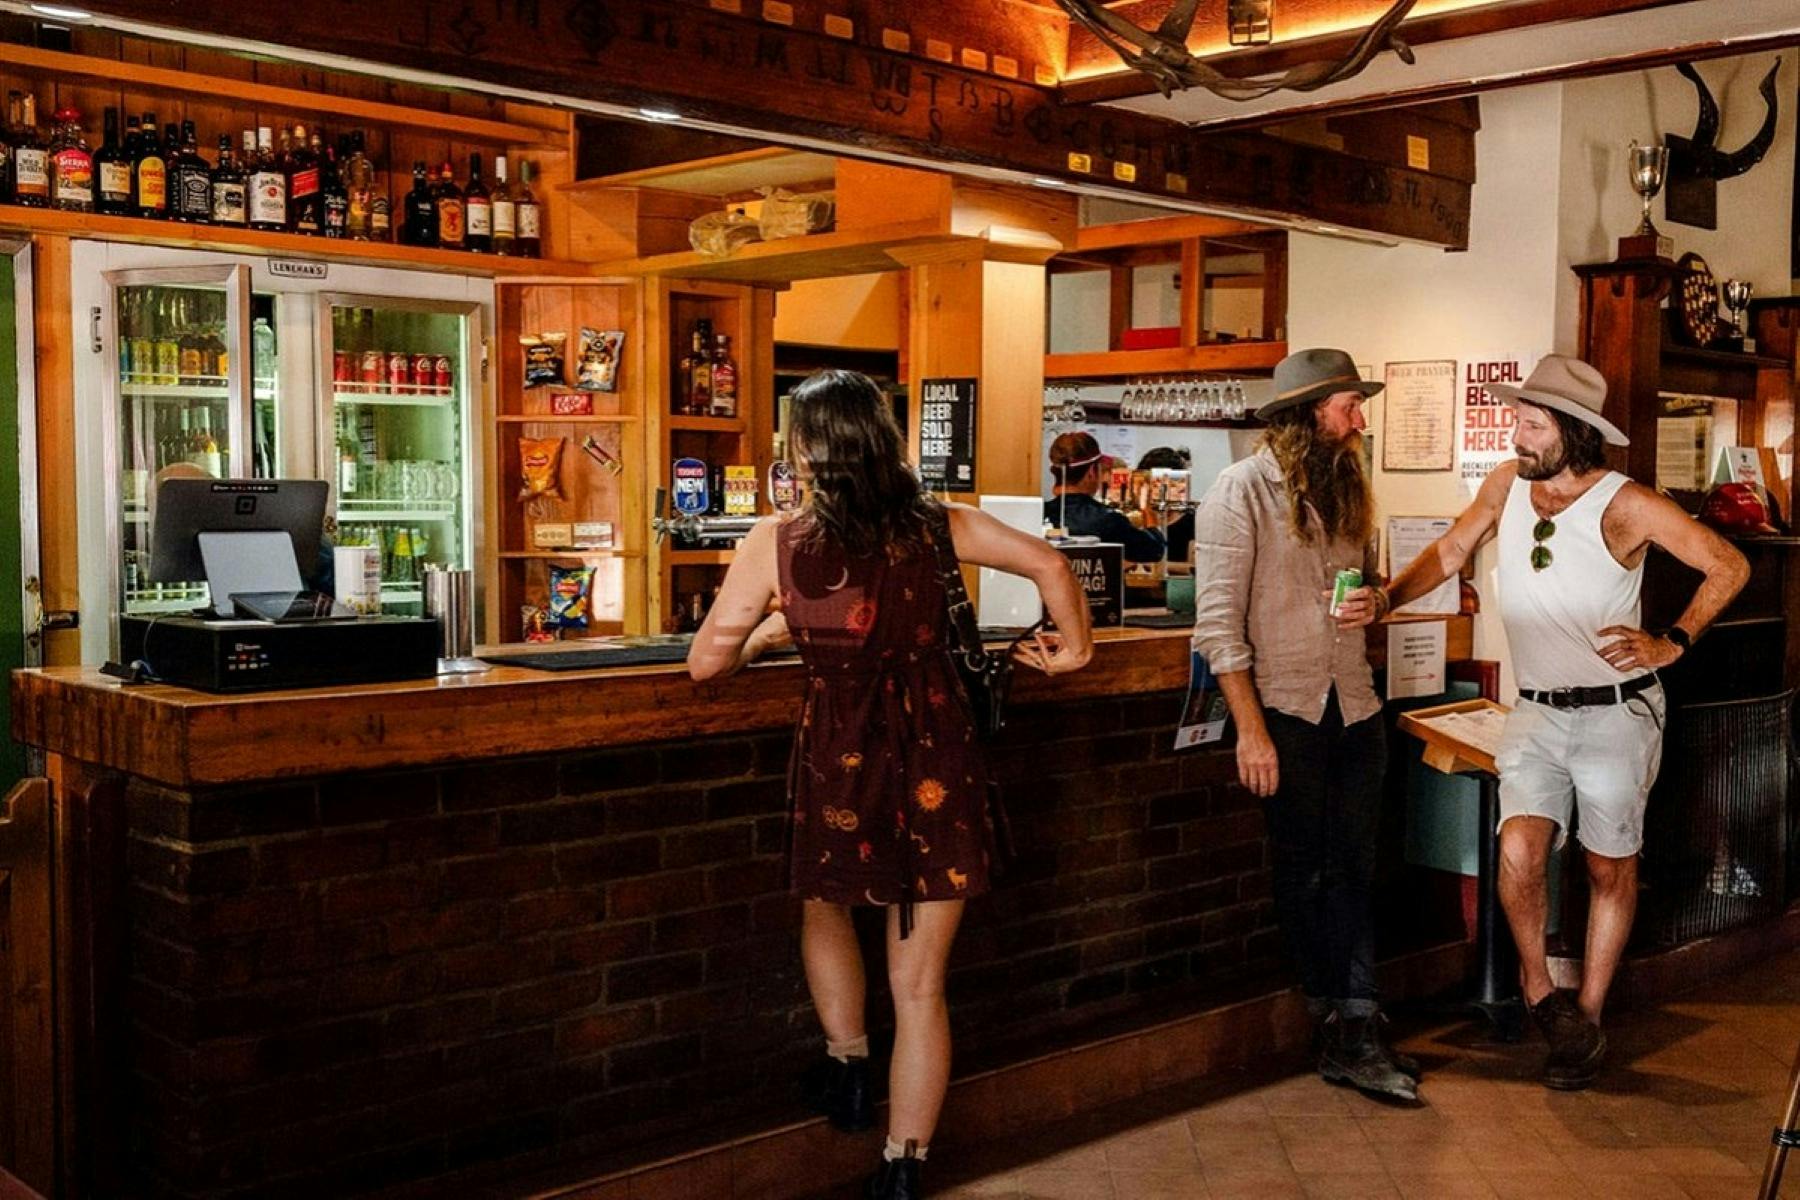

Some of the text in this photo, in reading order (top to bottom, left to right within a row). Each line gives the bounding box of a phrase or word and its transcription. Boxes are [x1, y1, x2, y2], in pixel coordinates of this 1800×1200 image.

[1467, 361, 1522, 382] LOCAL
[924, 384, 959, 402] LOCAL
[1466, 386, 1502, 406] BE
[923, 403, 952, 420] BEER
[1465, 408, 1514, 429] SOLD
[921, 421, 952, 439] SOLD
[921, 440, 952, 456] HERE
[1464, 431, 1508, 451] HERE
[677, 479, 704, 494] NEW
[1094, 558, 1105, 574] A
[1079, 576, 1106, 591] AG!
